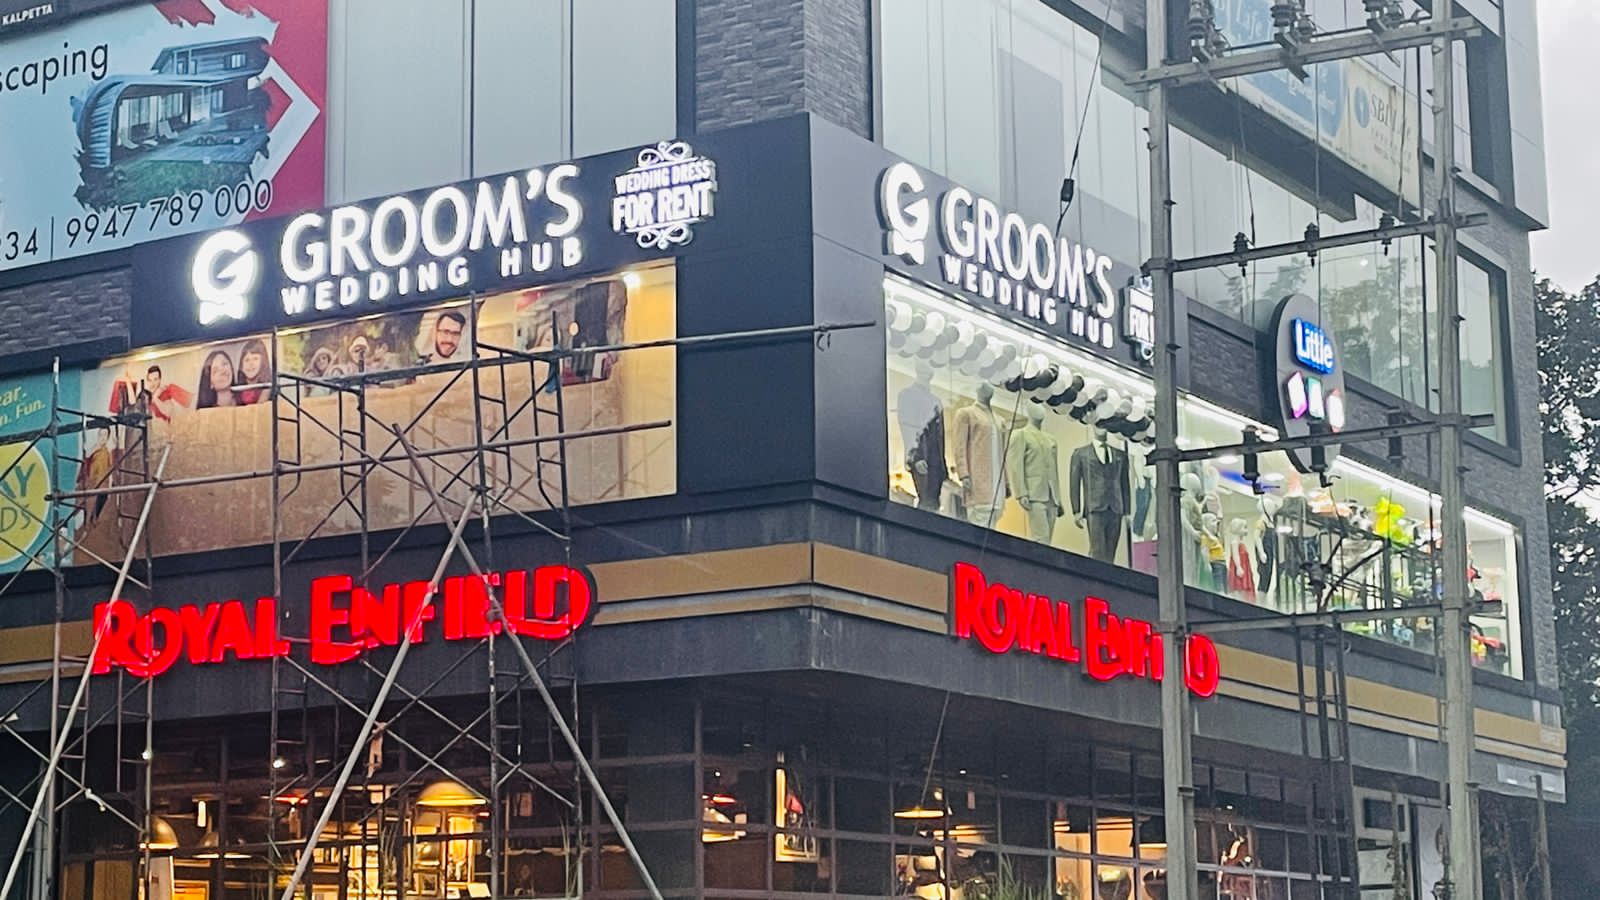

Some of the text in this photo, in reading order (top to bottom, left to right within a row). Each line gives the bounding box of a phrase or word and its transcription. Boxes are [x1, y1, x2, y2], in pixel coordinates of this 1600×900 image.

[2, 4, 53, 25] KALPETTA
[0, 41, 108, 94] caping
[612, 181, 714, 233] FOR RENT
[615, 159, 714, 195] WEDDING DRESS
[0, 179, 272, 260] 34 9947 789 000
[280, 164, 583, 283] GROOM'S
[942, 186, 1115, 319] GROOM'S
[280, 236, 583, 316] WEDDING HUB
[943, 253, 1057, 325] WEDDING
[1070, 308, 1114, 349] HUB
[1294, 318, 1334, 369] Little
[0, 386, 27, 406] ar.
[15, 400, 46, 419] Fun.
[92, 565, 591, 678] ROYAL ENFIELD
[955, 561, 1220, 697] ROYAL ENFID
